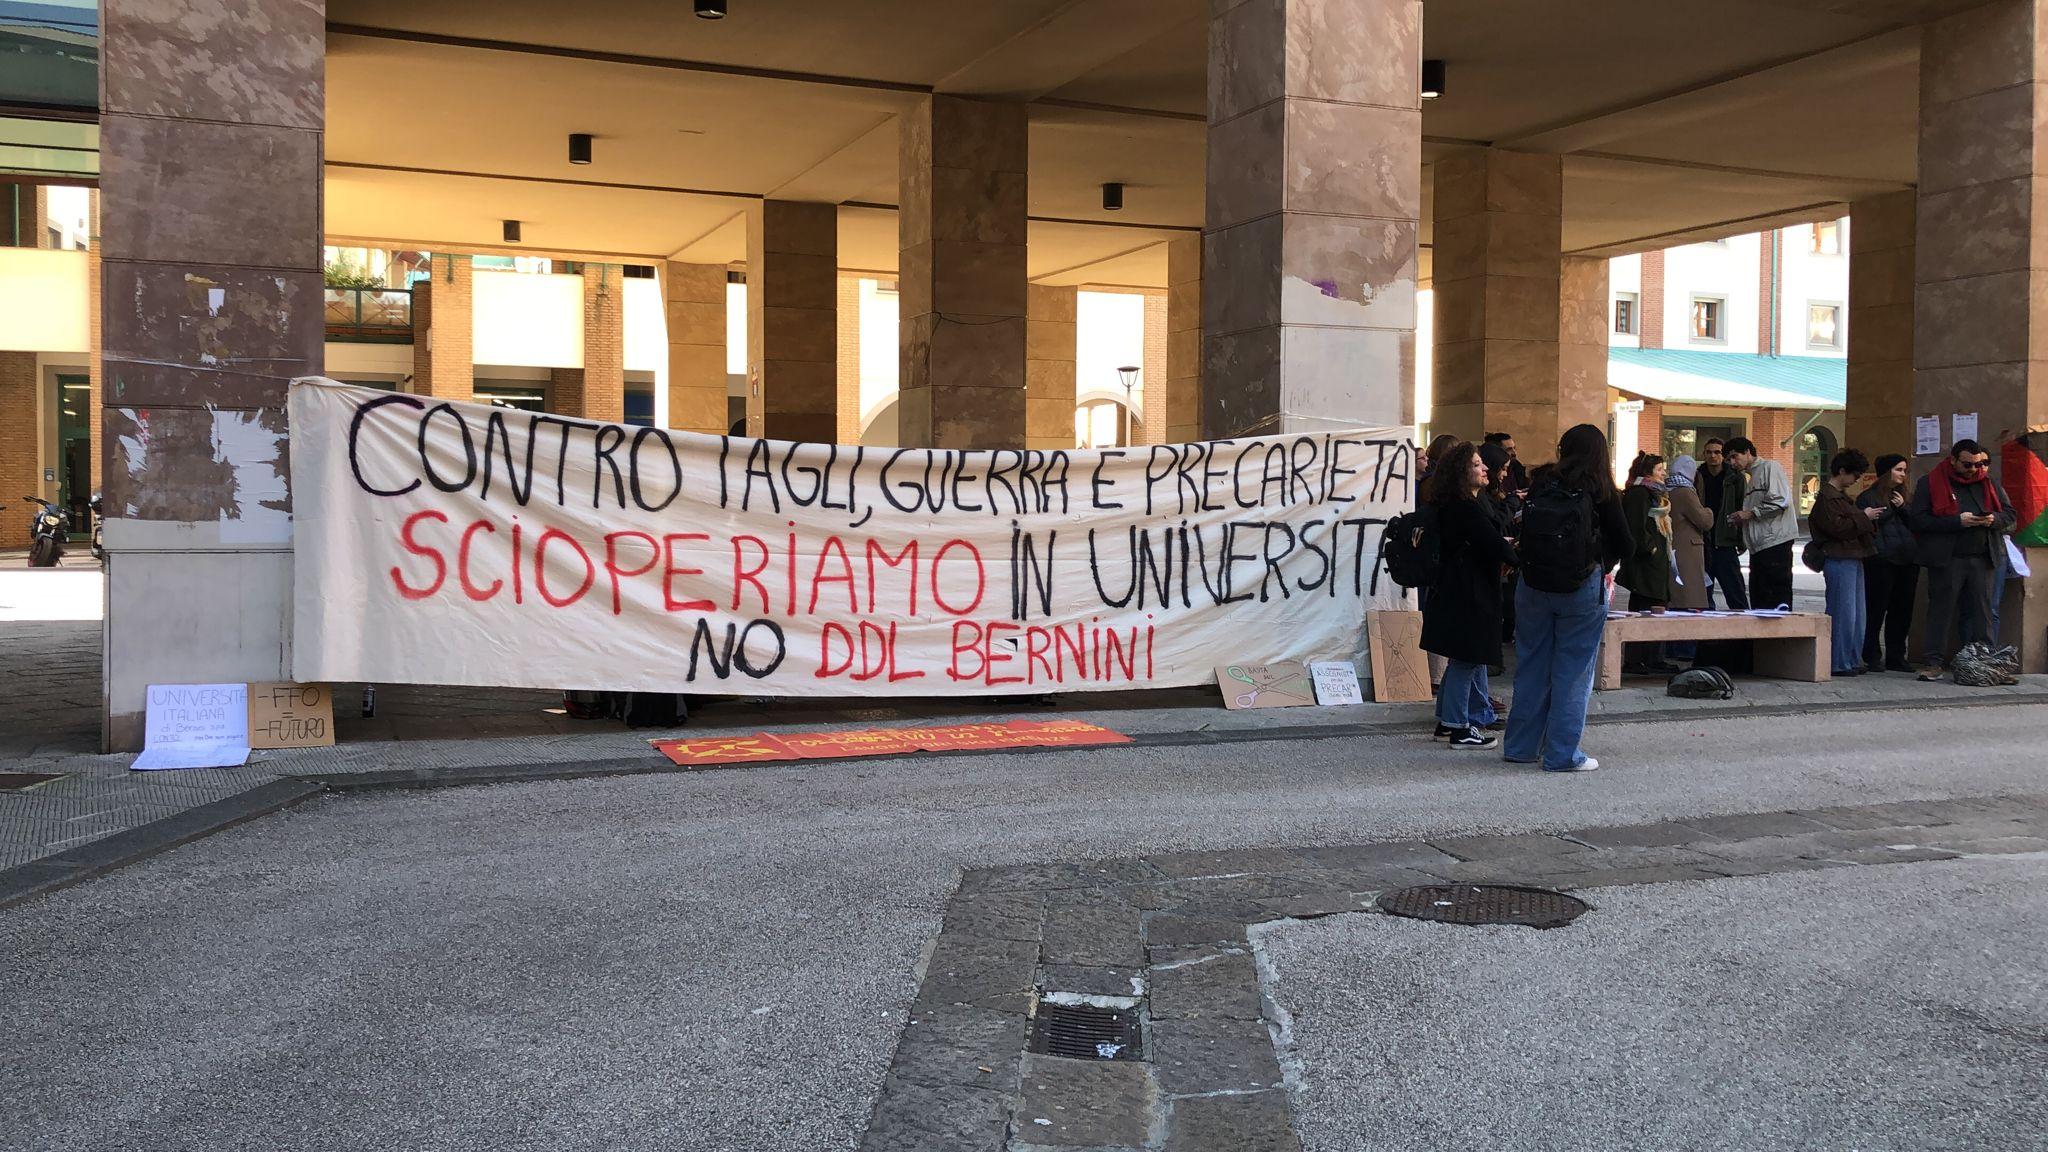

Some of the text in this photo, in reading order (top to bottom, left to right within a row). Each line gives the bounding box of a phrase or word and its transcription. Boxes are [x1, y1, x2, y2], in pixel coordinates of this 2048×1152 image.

[349, 395, 683, 511] CONTRO
[880, 448, 1069, 515] GUERRA
[1093, 452, 1125, 509] E
[389, 510, 985, 616] SCIOPERIAMO
[1010, 519, 1057, 620] IN
[686, 614, 1154, 686] NO DDL BERNINI
[163, 708, 225, 722] ITALIANA
